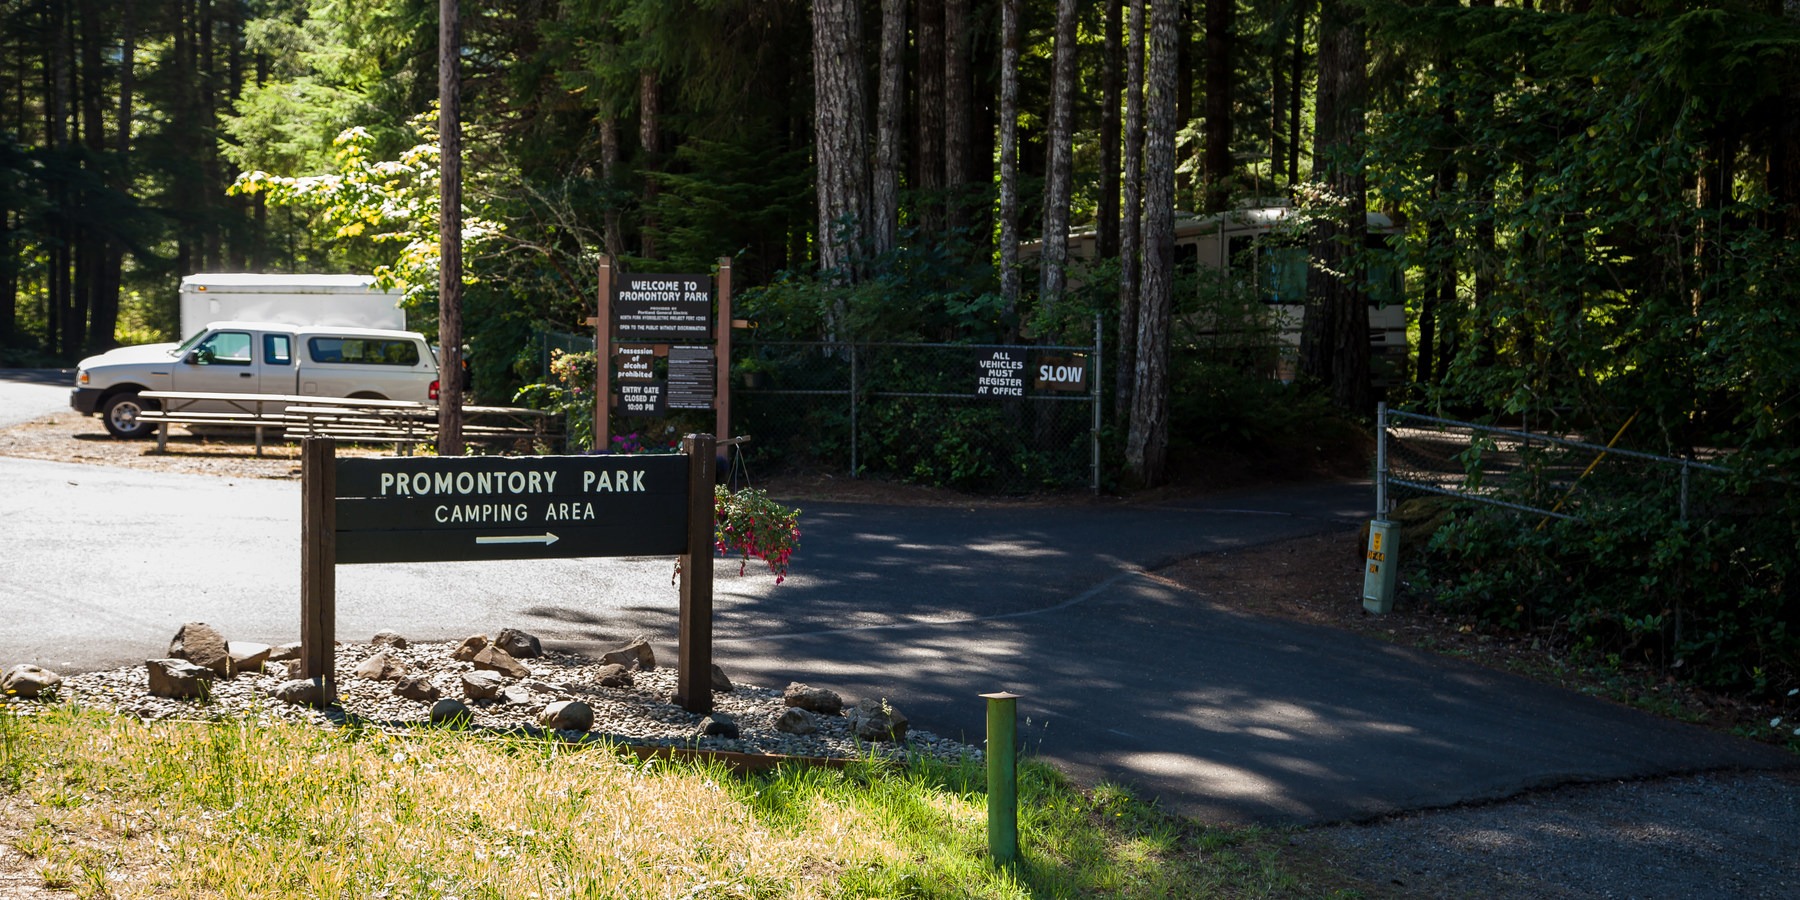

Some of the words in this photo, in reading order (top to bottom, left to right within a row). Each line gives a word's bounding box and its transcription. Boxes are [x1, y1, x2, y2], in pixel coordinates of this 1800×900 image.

[632, 280, 678, 291] WELCOME
[684, 281, 697, 291] TO
[620, 291, 680, 302] PROMONTORY
[684, 292, 708, 302] PARK
[980, 360, 1023, 369] VEHICLES
[1040, 365, 1082, 382] SLOW
[979, 377, 1022, 386] REGISTER
[992, 387, 1022, 396] OFFICE
[380, 471, 557, 496] PROMONTORY
[583, 470, 646, 492] PARK
[434, 504, 528, 522] CAMPING
[546, 502, 596, 521] AREA
